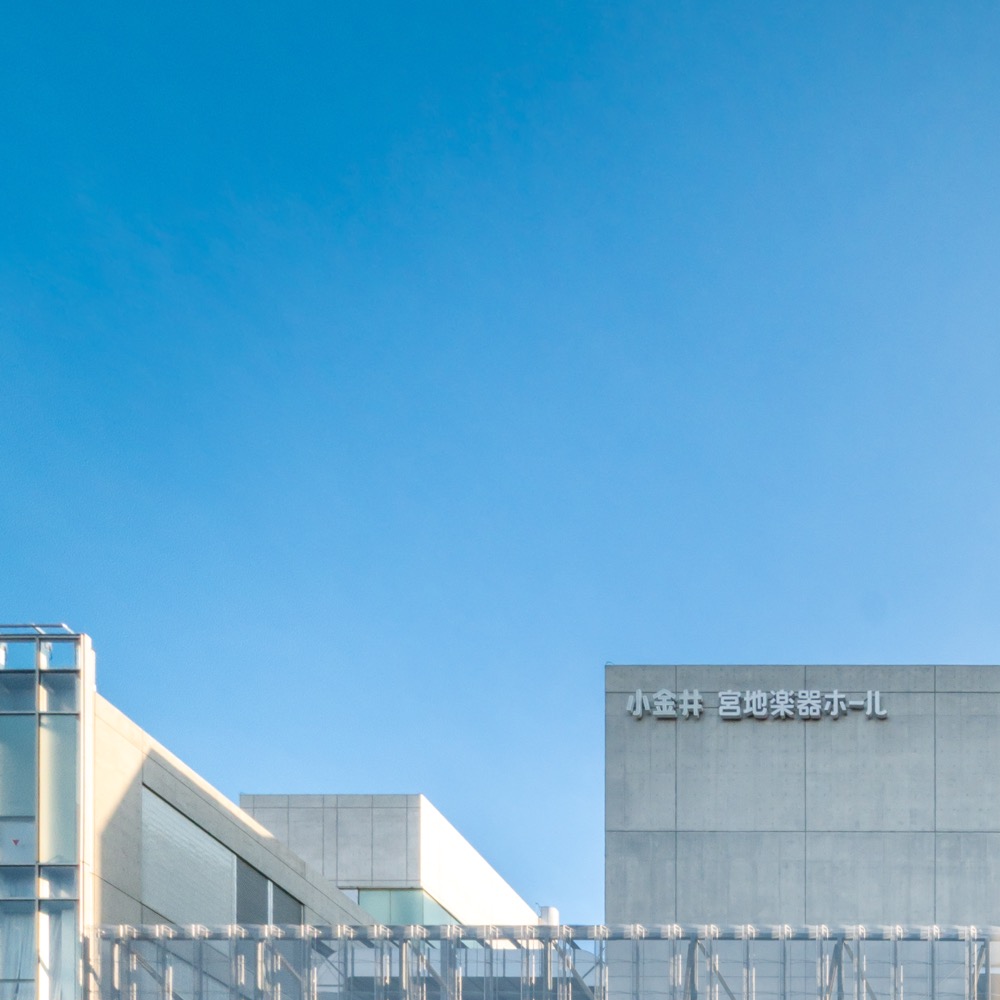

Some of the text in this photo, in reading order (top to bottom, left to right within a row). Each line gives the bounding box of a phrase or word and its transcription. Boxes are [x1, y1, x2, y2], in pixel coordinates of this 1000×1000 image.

[626, 688, 888, 720] 小金井 宮地楽器ホール
